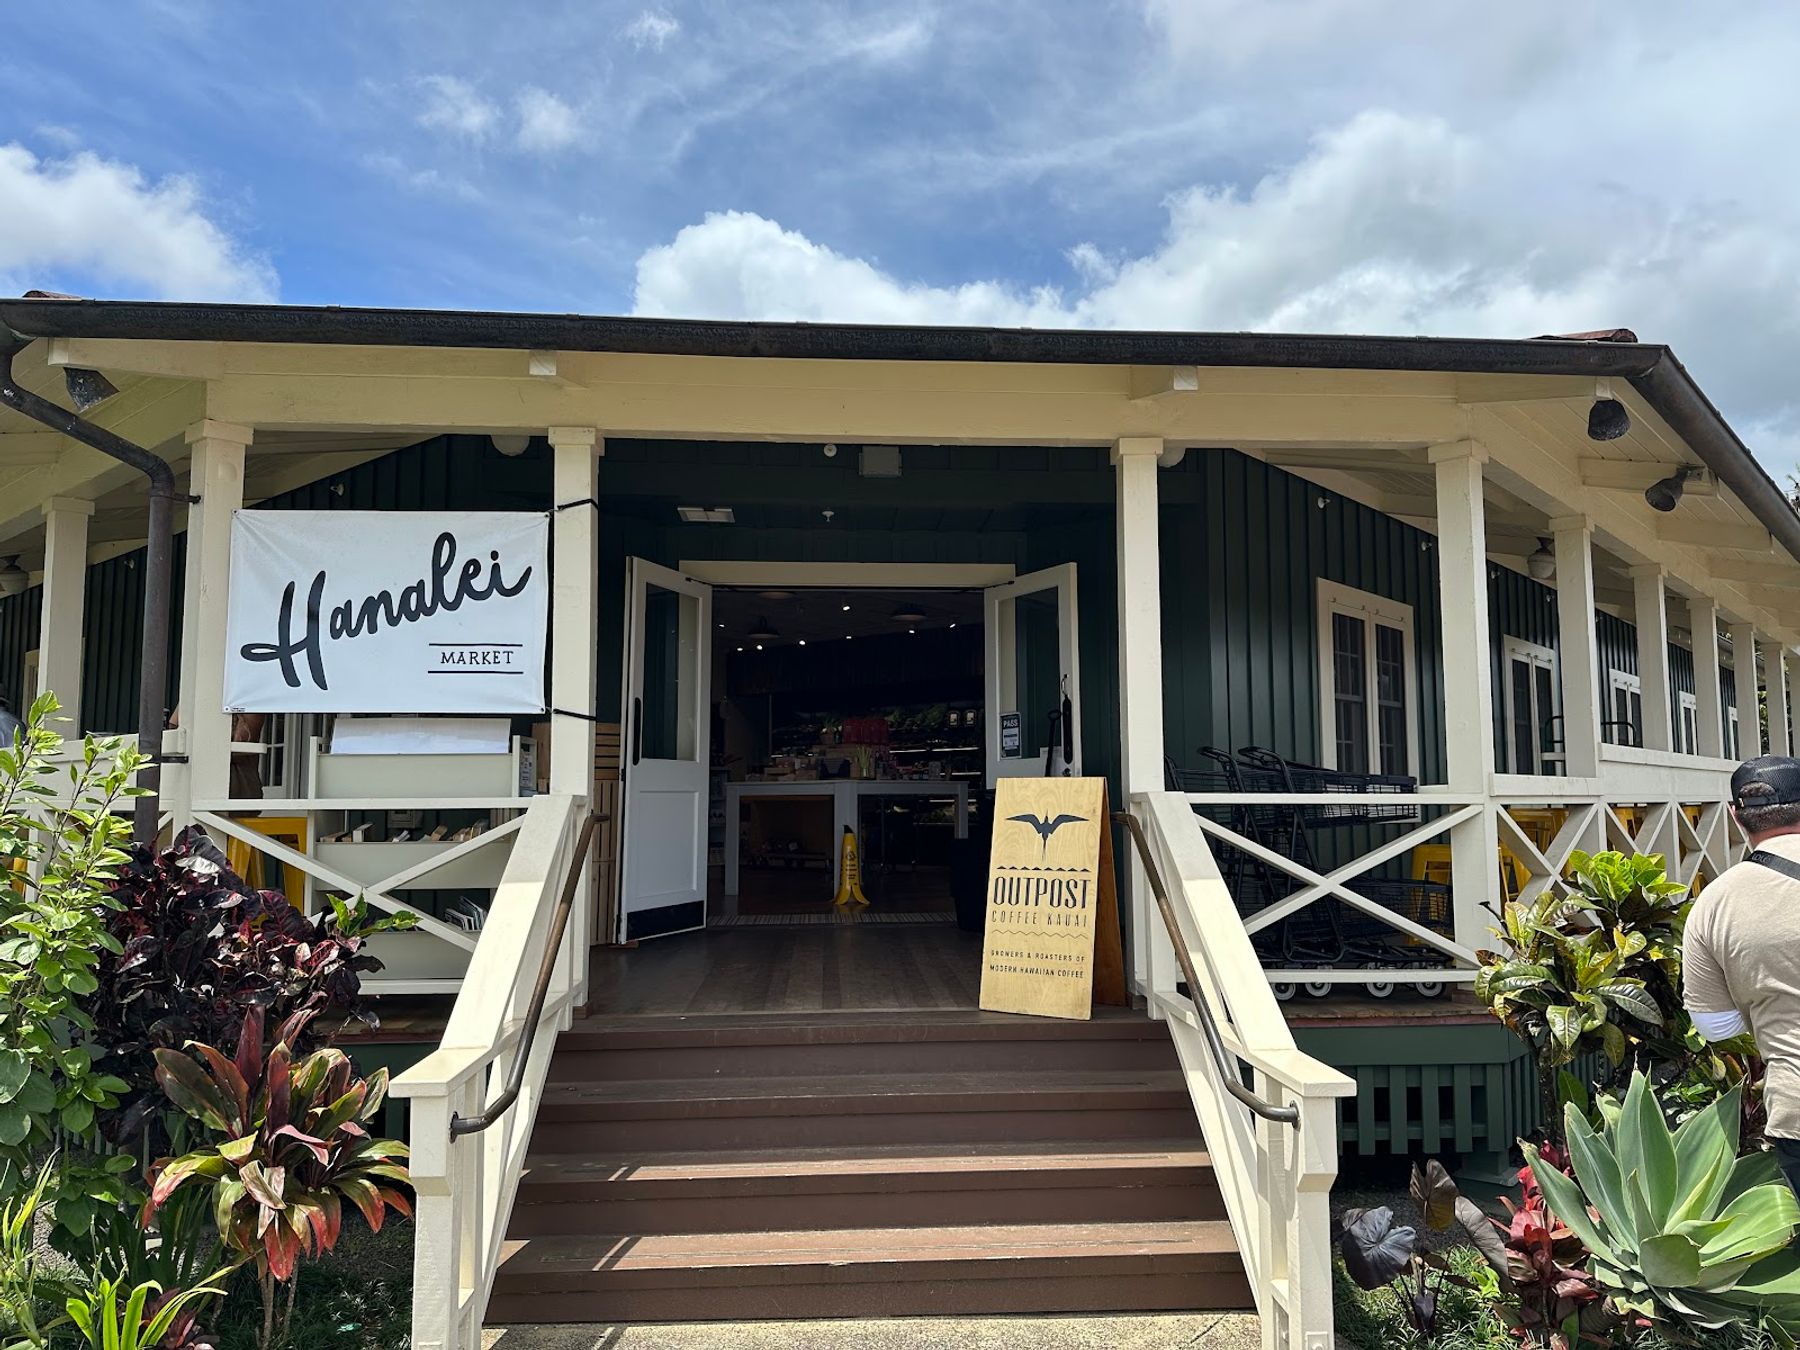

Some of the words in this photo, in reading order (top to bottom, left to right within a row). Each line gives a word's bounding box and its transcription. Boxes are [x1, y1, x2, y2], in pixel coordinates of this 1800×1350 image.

[240, 531, 533, 690] Hanalei
[440, 650, 515, 665] MARKET
[1003, 719, 1018, 727] PASS
[993, 876, 1091, 909] OUTPOST
[992, 910, 1037, 924] COFFEE
[1047, 913, 1087, 927] KAUAI
[991, 949, 1024, 958] GROWERS
[1035, 952, 1072, 961] ROASTERS
[1075, 955, 1085, 963] OF
[990, 964, 1017, 973] MODERN
[1057, 970, 1084, 978] COFFEE
